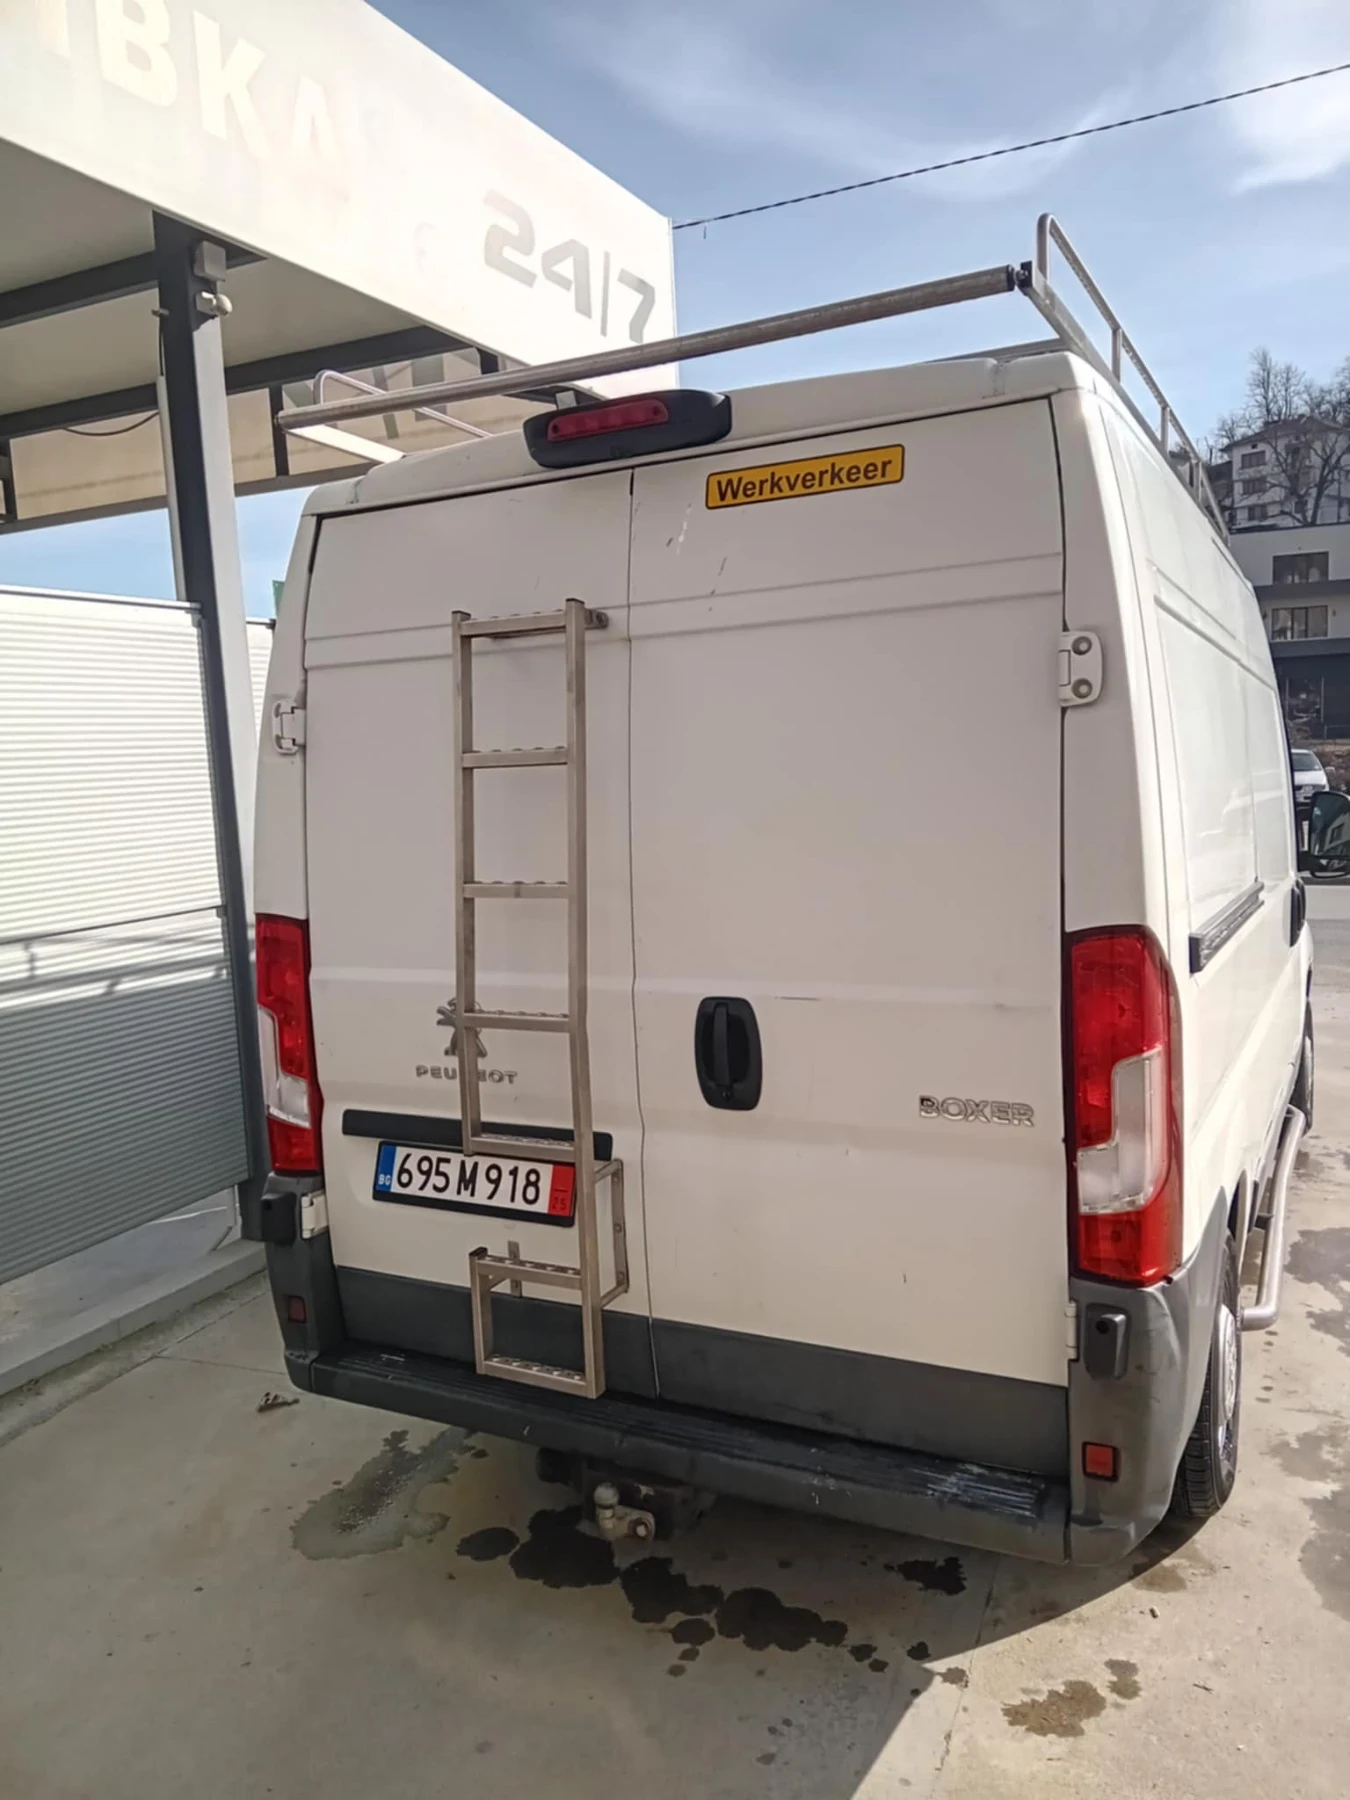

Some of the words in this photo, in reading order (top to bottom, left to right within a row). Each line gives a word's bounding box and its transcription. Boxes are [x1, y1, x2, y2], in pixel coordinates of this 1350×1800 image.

[716, 459, 893, 502] Werkverkeer
[415, 1065, 518, 1084] PEUEOT
[919, 1095, 1035, 1127] BOXER
[378, 1173, 391, 1186] BG
